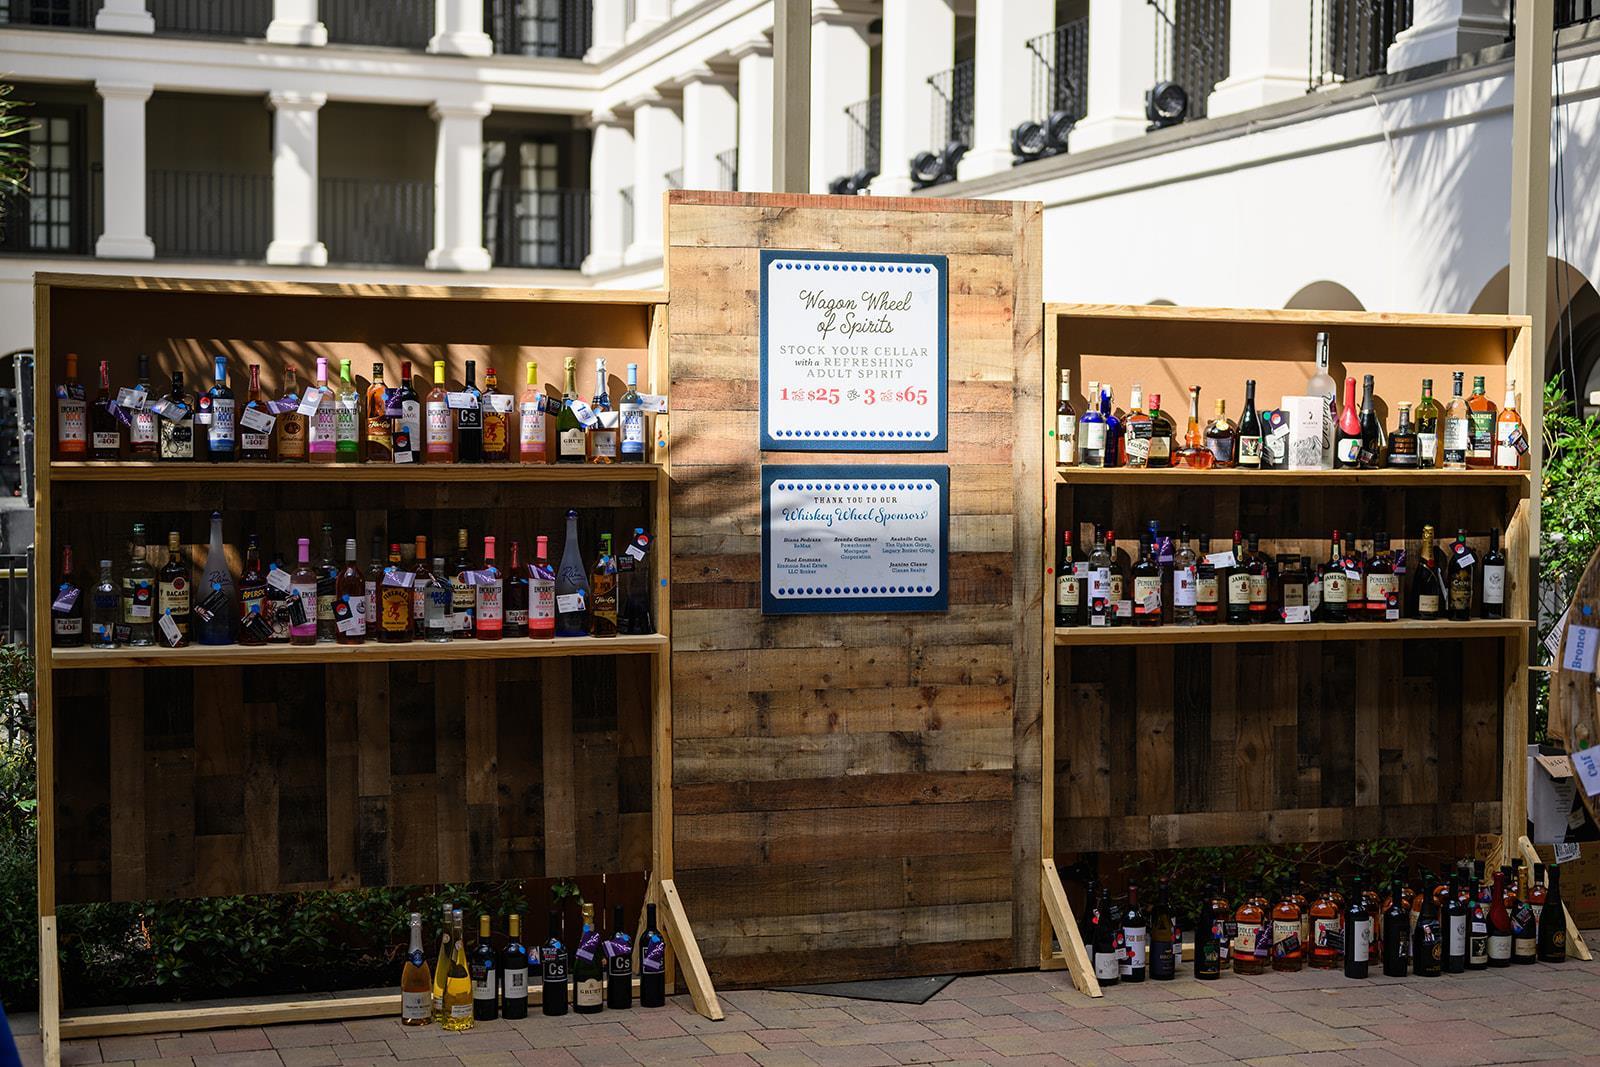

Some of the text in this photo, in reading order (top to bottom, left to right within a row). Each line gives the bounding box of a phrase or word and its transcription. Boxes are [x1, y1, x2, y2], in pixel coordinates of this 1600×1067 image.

[799, 290, 912, 317] Wagon Wheel
[817, 312, 894, 340] of Spirits
[780, 345, 928, 357] STOCK YOUR CELLAR
[795, 358, 813, 367] with
[824, 358, 914, 368] REFRESHING
[806, 369, 903, 379] ADULT SPIRIT
[780, 388, 789, 401] 1
[807, 388, 840, 405] $25
[864, 389, 876, 405] 3
[896, 386, 928, 405] $65
[461, 409, 476, 422] Cs
[782, 507, 928, 527] Whiskey Wheel Sponsors
[1572, 628, 1586, 669] Bronco
[1580, 755, 1598, 777] Calf
[549, 962, 564, 975] Cs
[615, 956, 630, 969] Cs
